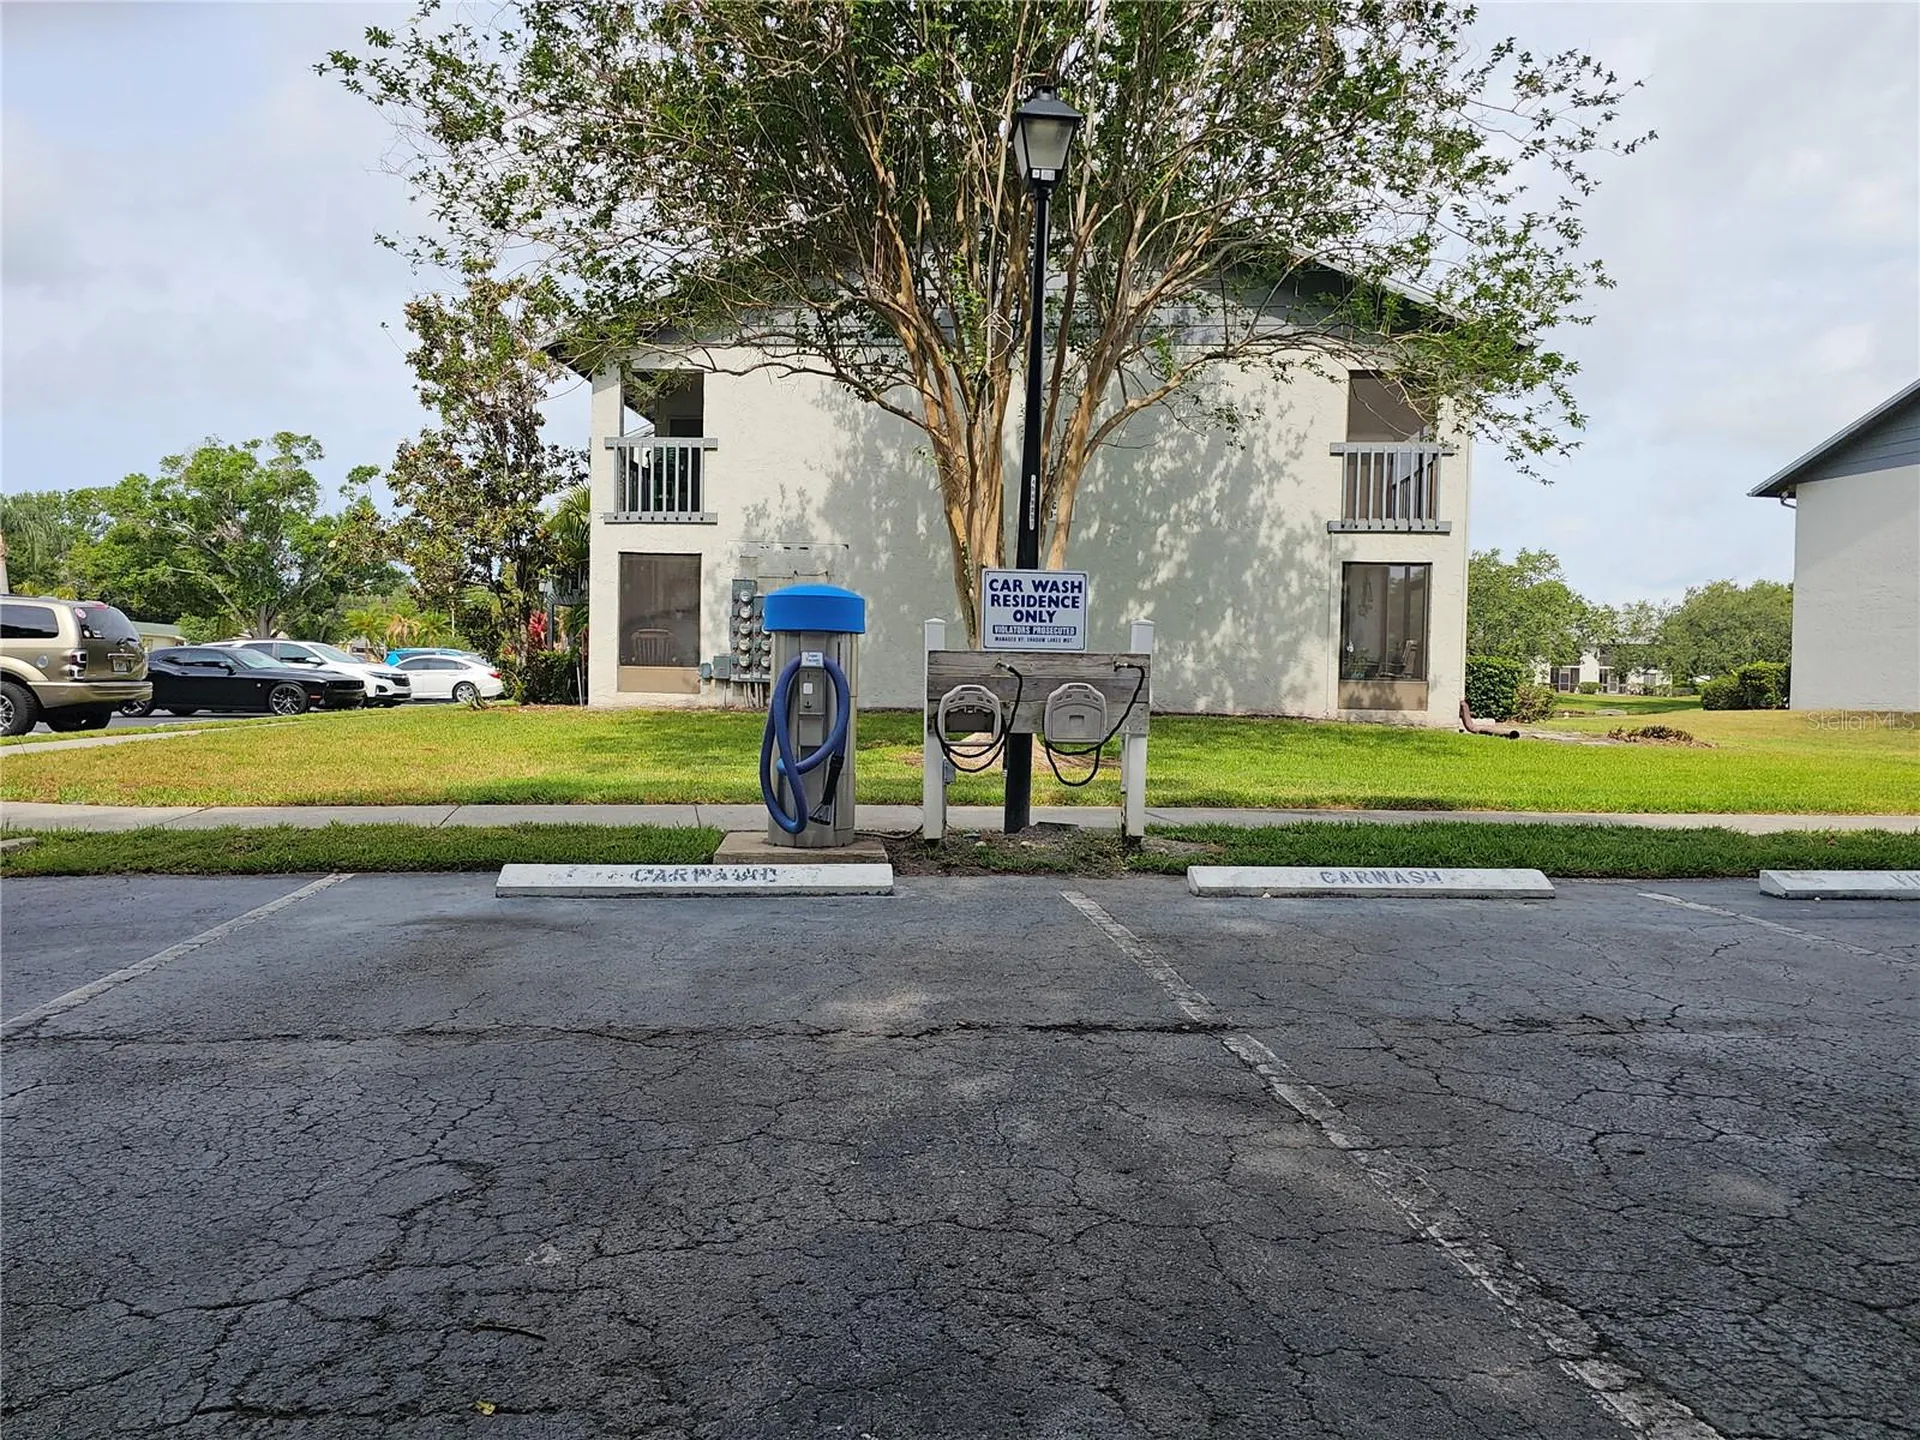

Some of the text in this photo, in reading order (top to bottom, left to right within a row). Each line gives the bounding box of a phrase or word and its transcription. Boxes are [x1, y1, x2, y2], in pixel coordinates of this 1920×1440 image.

[988, 578, 1083, 594] CAR WASH
[990, 594, 1080, 609] RESIDENCE
[1012, 609, 1057, 623] ONLY
[994, 626, 1075, 636] VIOLATORS PROSECUTED
[1319, 870, 1444, 884] CARWASH
